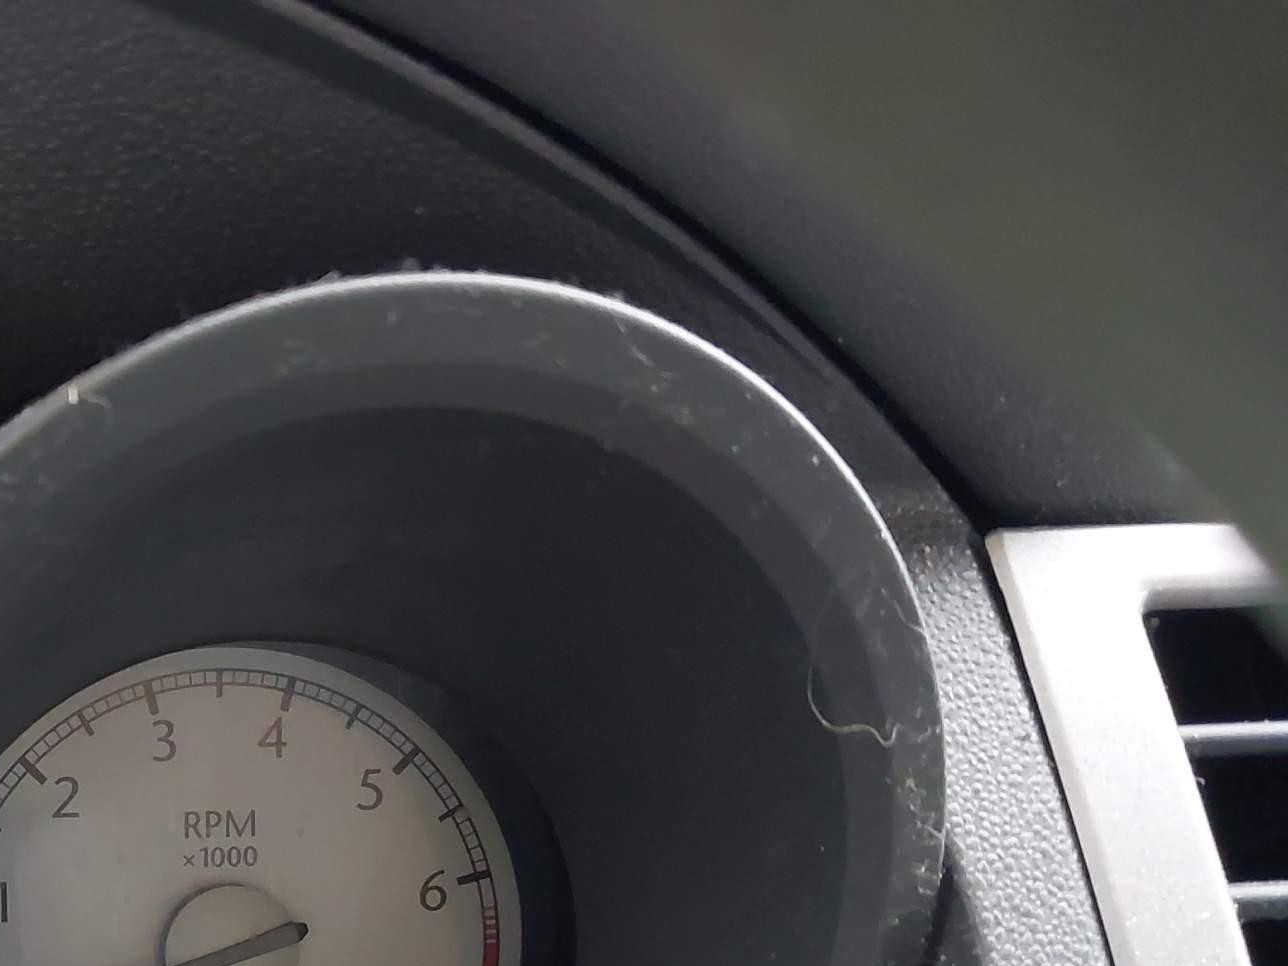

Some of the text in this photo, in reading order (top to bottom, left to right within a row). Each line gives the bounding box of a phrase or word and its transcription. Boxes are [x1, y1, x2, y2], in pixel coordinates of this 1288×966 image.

[152, 719, 177, 762] 3
[257, 717, 287, 758] 4
[52, 776, 80, 818] 2
[356, 769, 383, 810] 5
[184, 809, 257, 839] RPM
[419, 870, 447, 911] 6
